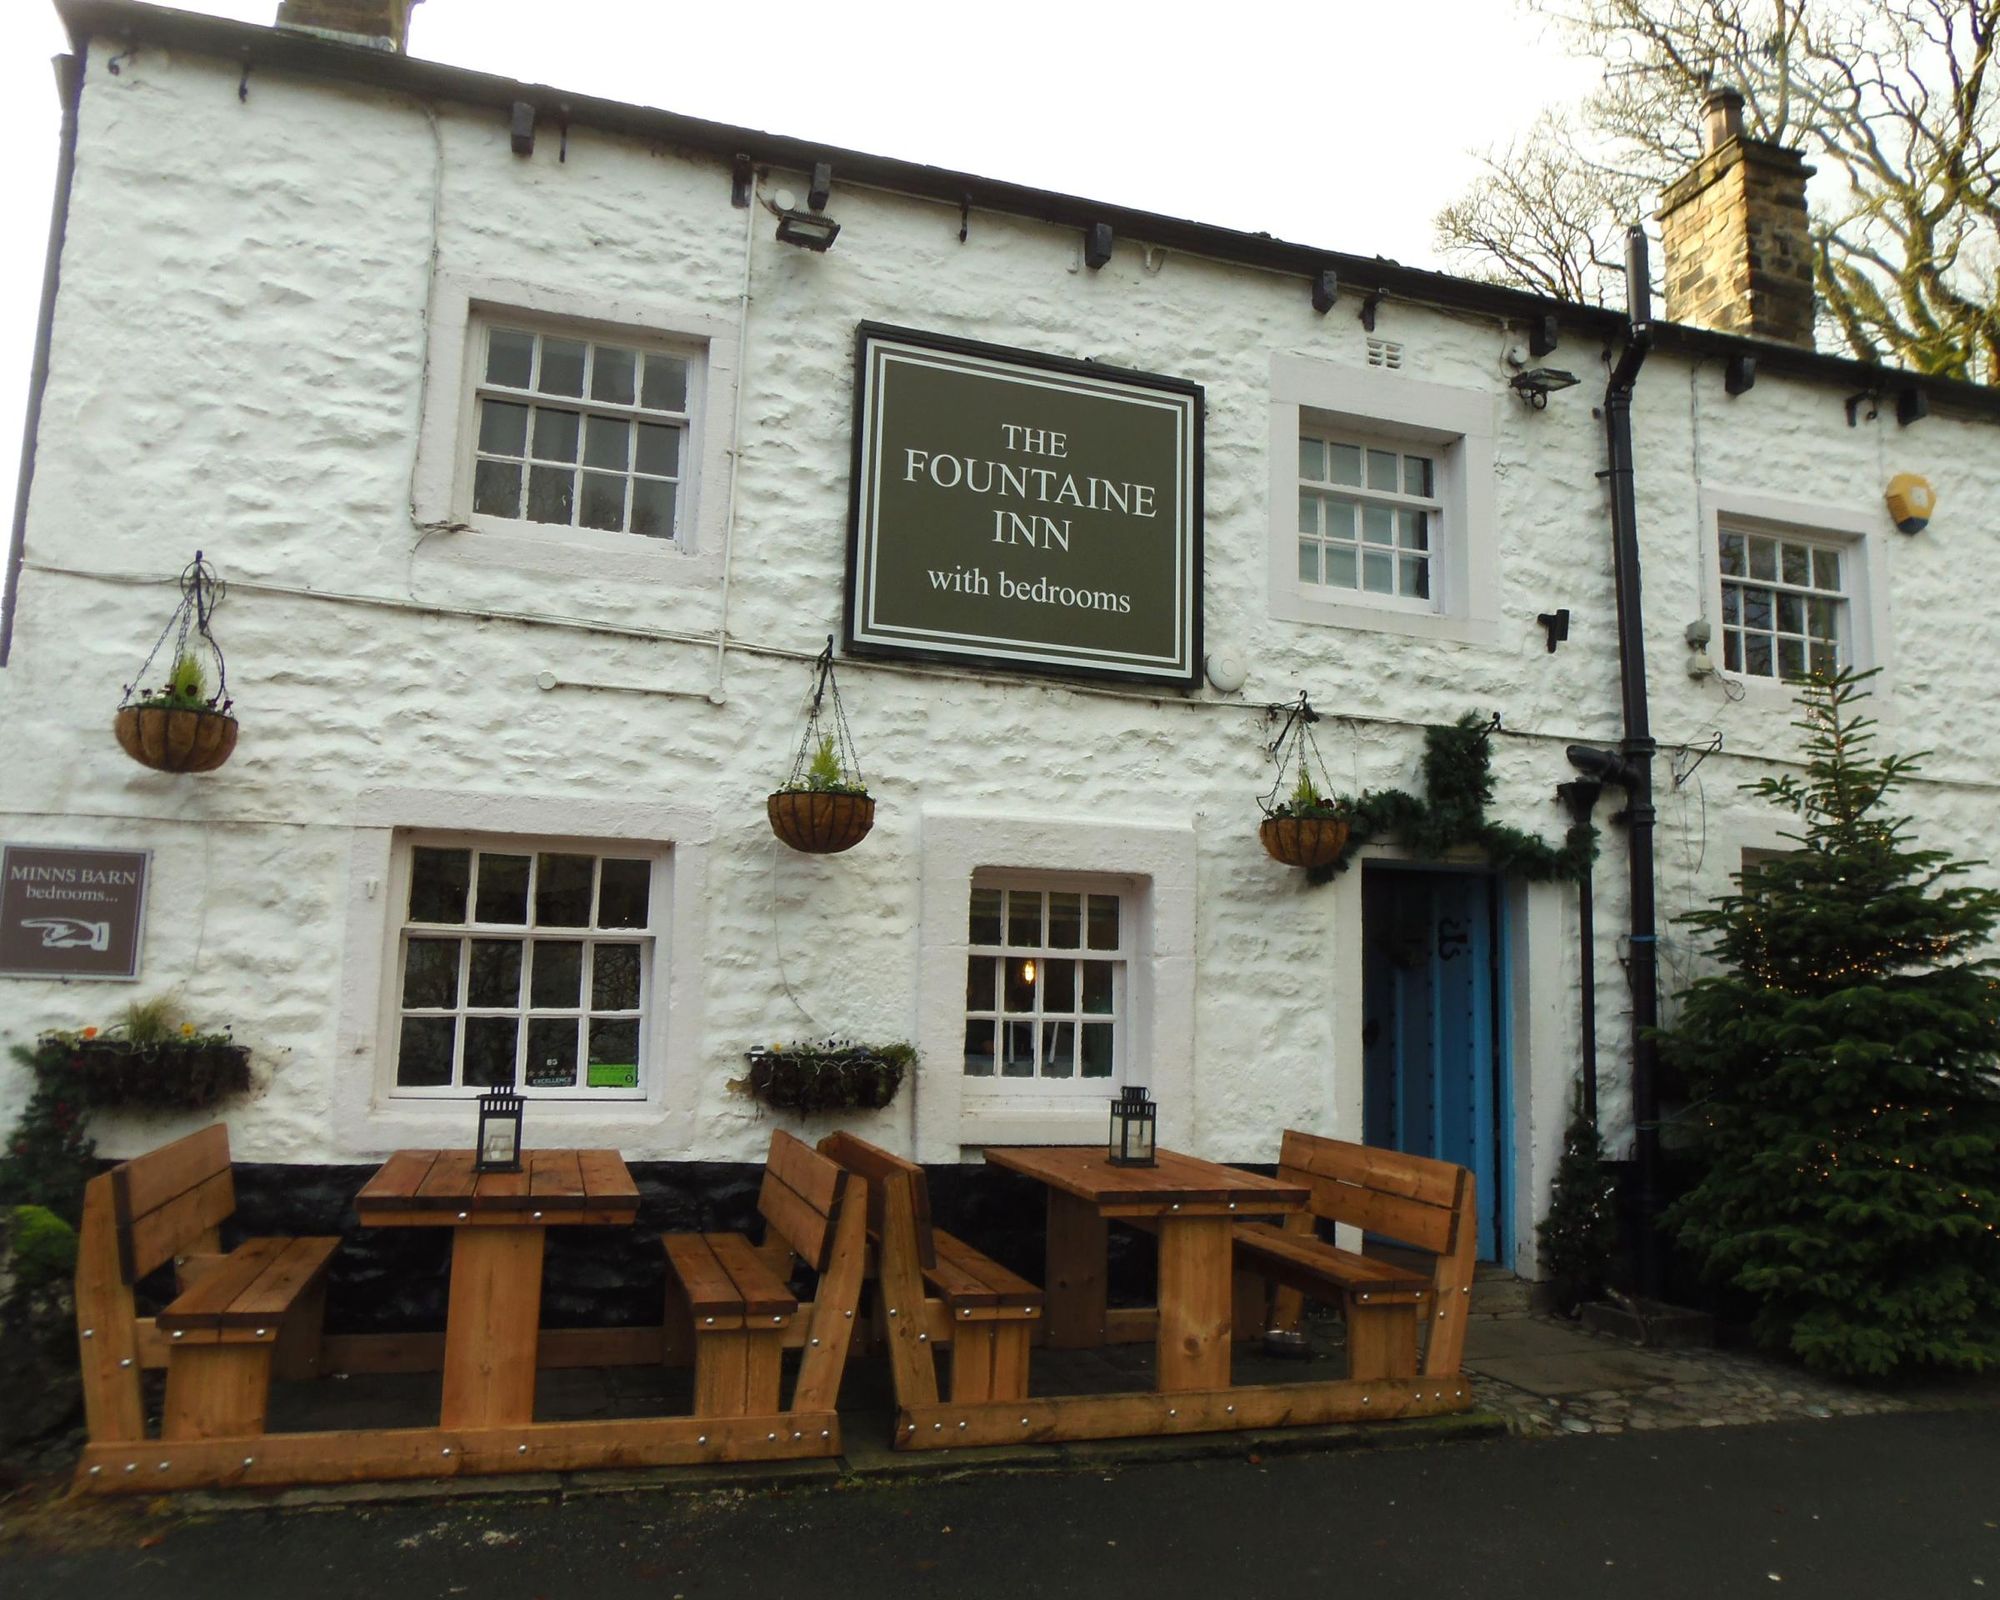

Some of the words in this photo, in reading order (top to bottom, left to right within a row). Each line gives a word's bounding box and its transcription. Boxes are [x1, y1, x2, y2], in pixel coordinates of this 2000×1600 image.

[1002, 424, 1068, 458] THE
[904, 449, 1158, 518] FOUNTAINE
[992, 510, 1073, 552] INN
[928, 566, 990, 595] with
[1000, 571, 1131, 614] bedrooms
[11, 866, 76, 882] MINNS
[82, 870, 137, 885] BARN
